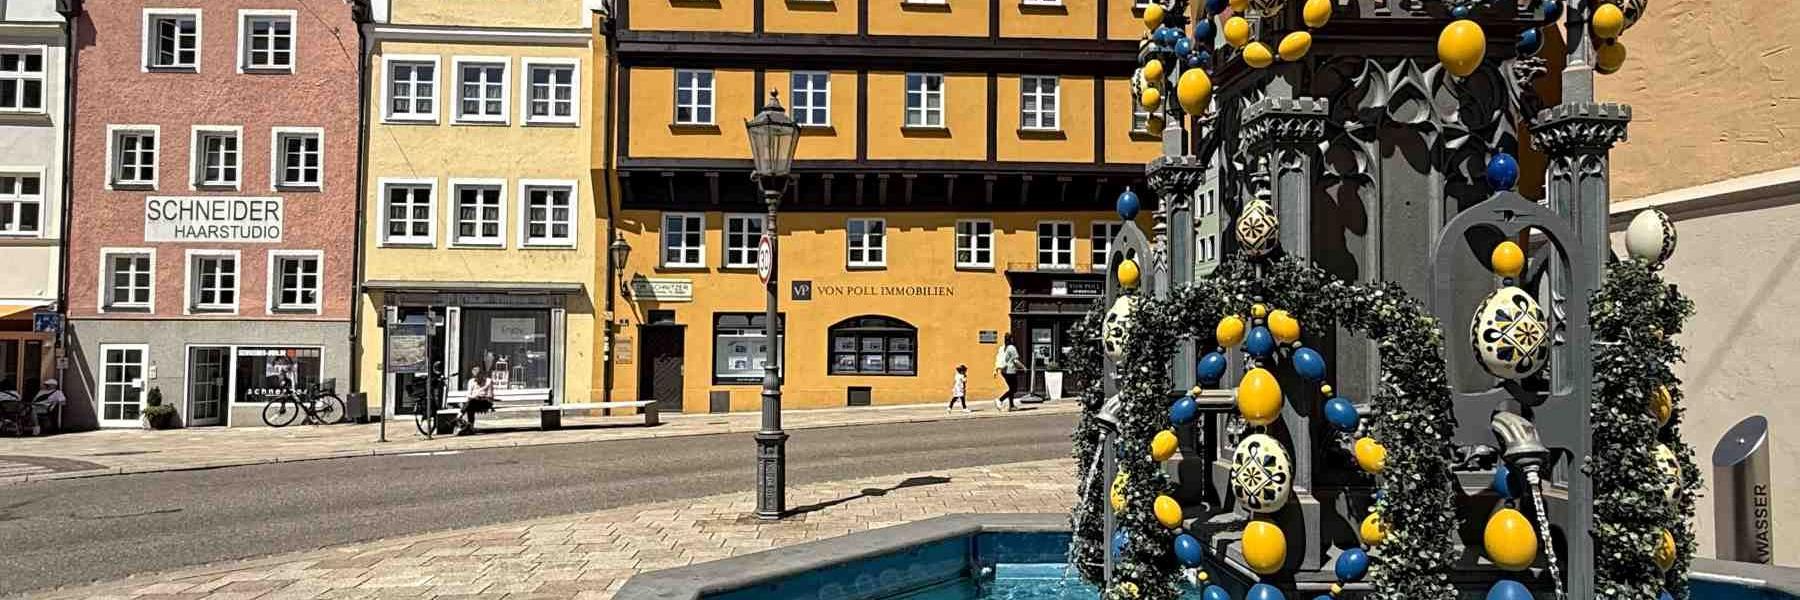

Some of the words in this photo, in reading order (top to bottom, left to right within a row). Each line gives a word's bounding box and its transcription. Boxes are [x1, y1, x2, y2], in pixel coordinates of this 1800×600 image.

[147, 199, 280, 222] SCHNEIDER
[174, 224, 280, 239] HAARSTUDIO
[760, 248, 769, 271] 30
[793, 285, 811, 297] VP
[817, 286, 844, 296] VON
[847, 286, 879, 296] POLL
[880, 286, 955, 297] IMMOBILIEN
